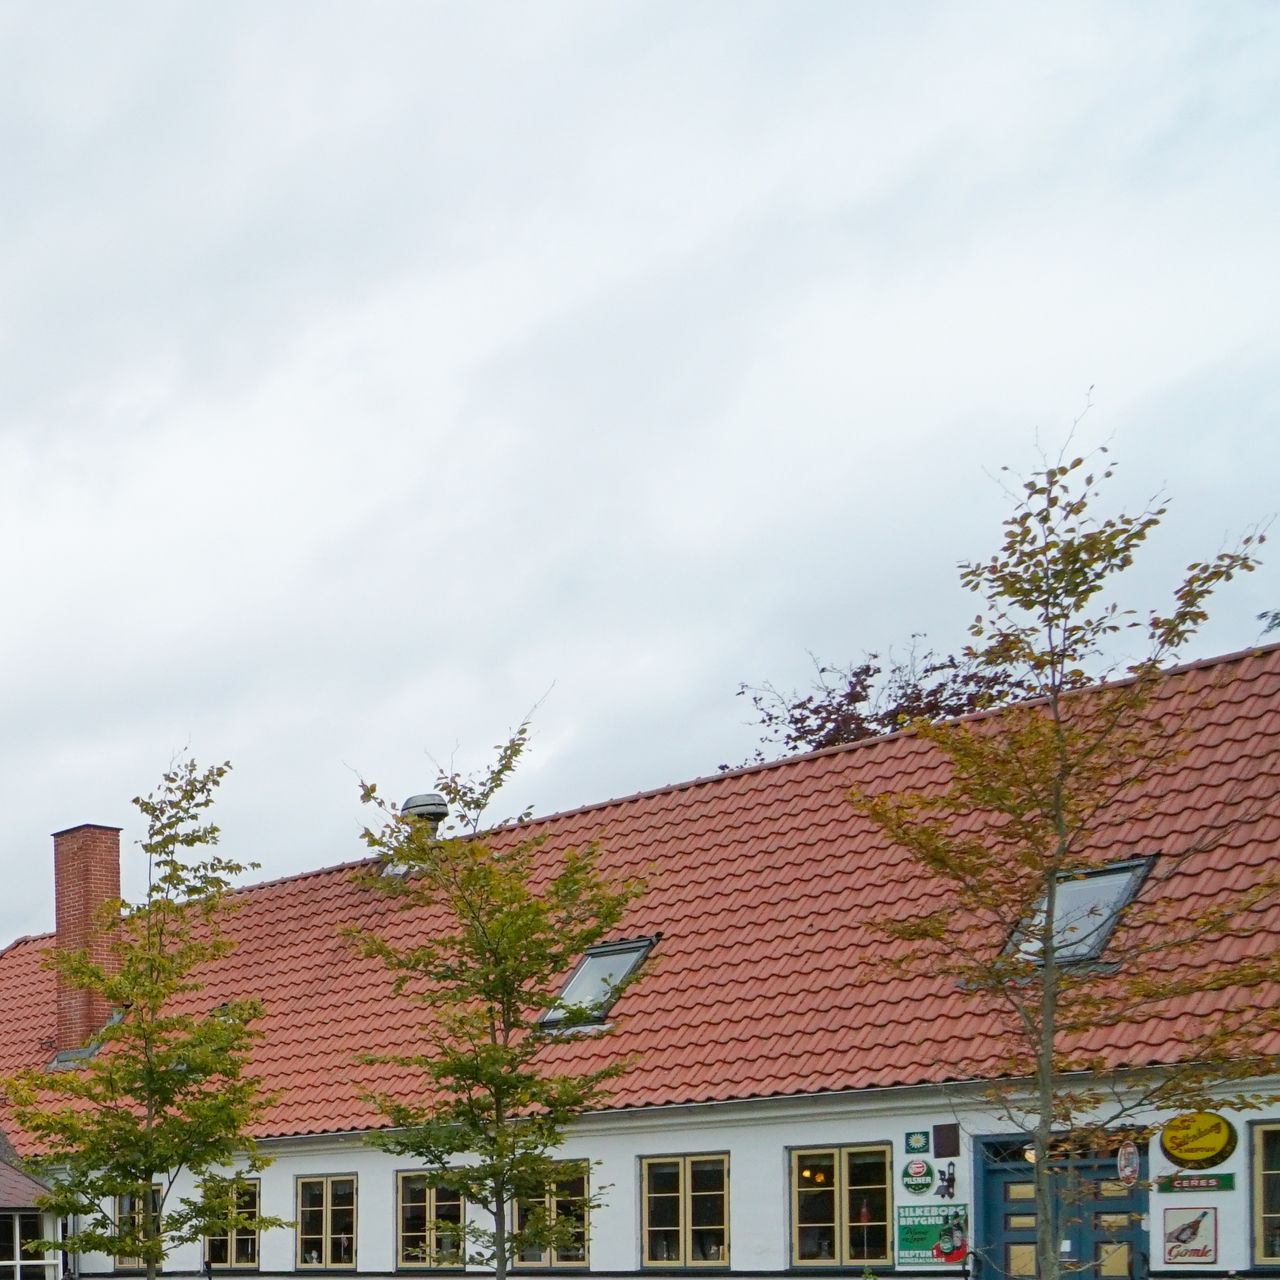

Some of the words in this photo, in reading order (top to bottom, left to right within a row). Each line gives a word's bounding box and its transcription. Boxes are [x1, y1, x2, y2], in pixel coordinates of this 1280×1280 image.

[903, 1176, 932, 1185] PILSNER
[1173, 1179, 1218, 1187] CERES
[898, 1206, 966, 1217] SILKEBORG
